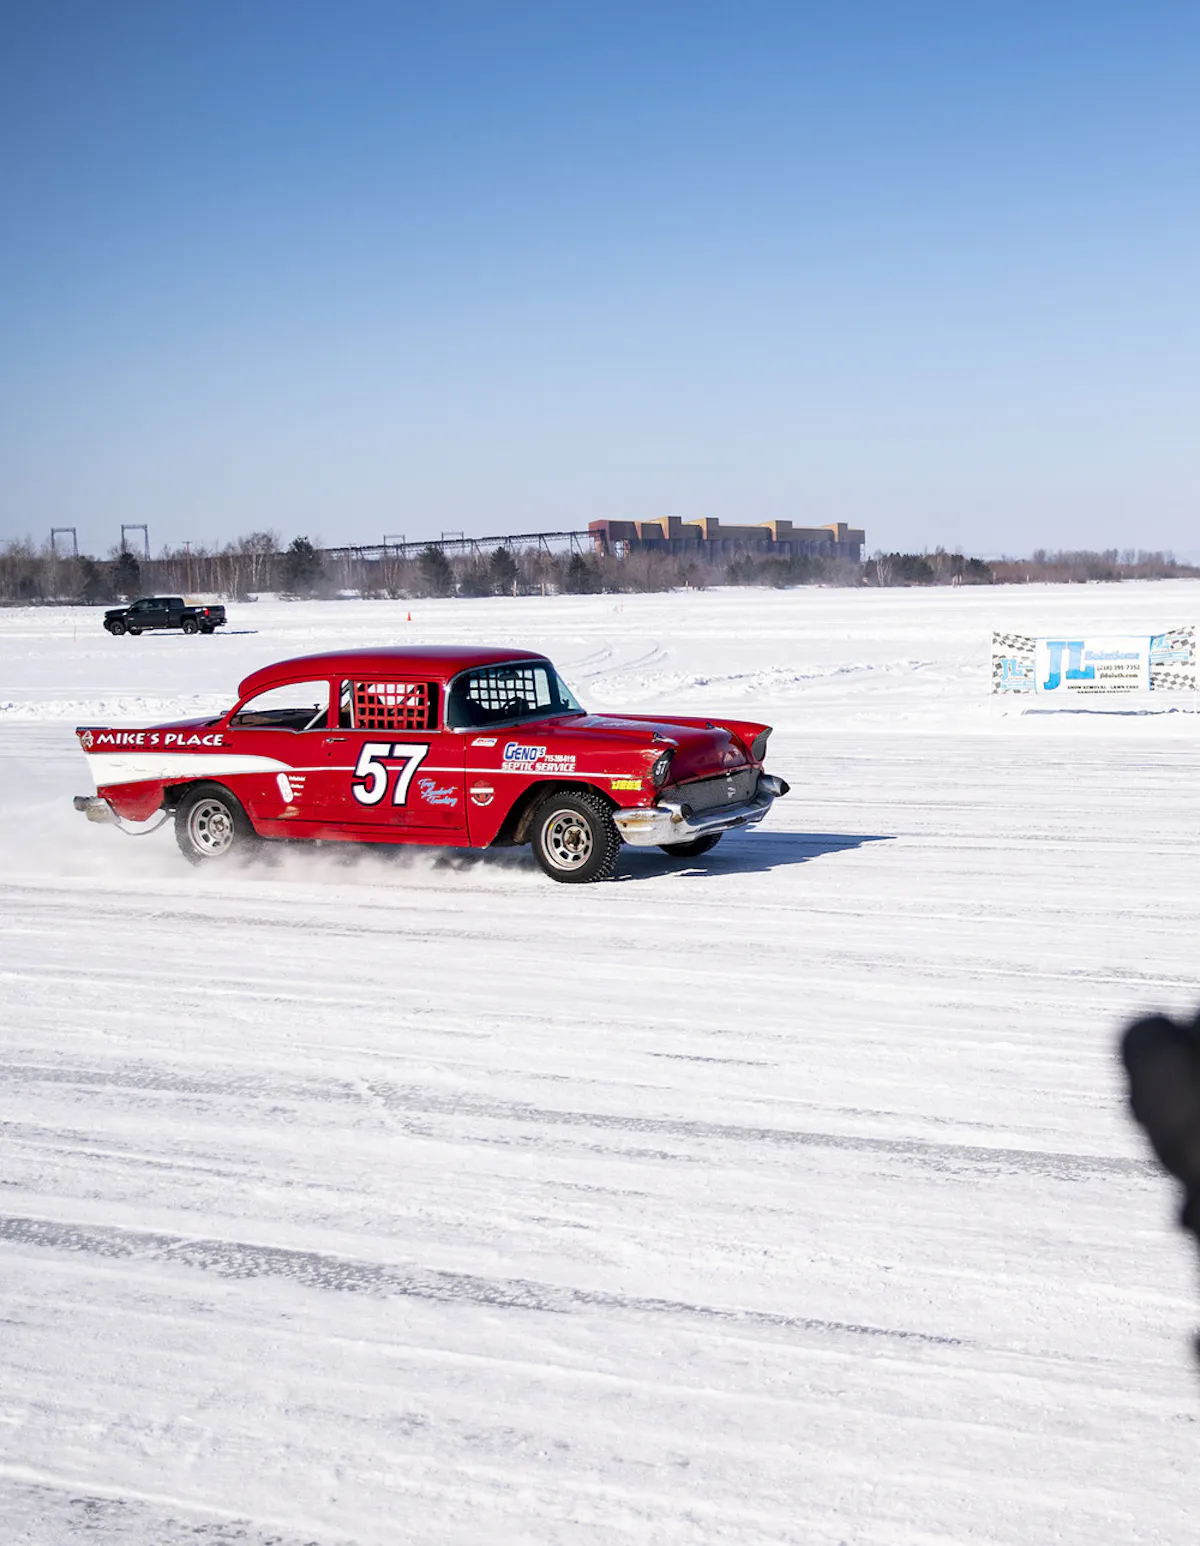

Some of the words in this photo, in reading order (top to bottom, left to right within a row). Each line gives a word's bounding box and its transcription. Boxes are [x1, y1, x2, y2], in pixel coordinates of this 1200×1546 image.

[1043, 641, 1095, 690] JL
[97, 733, 160, 745] MIKE'S
[165, 733, 225, 746] PLACE
[351, 741, 431, 806] 57
[502, 761, 534, 771] SEPTIC
[535, 763, 576, 772] SERVICE
[655, 760, 668, 775] 57
